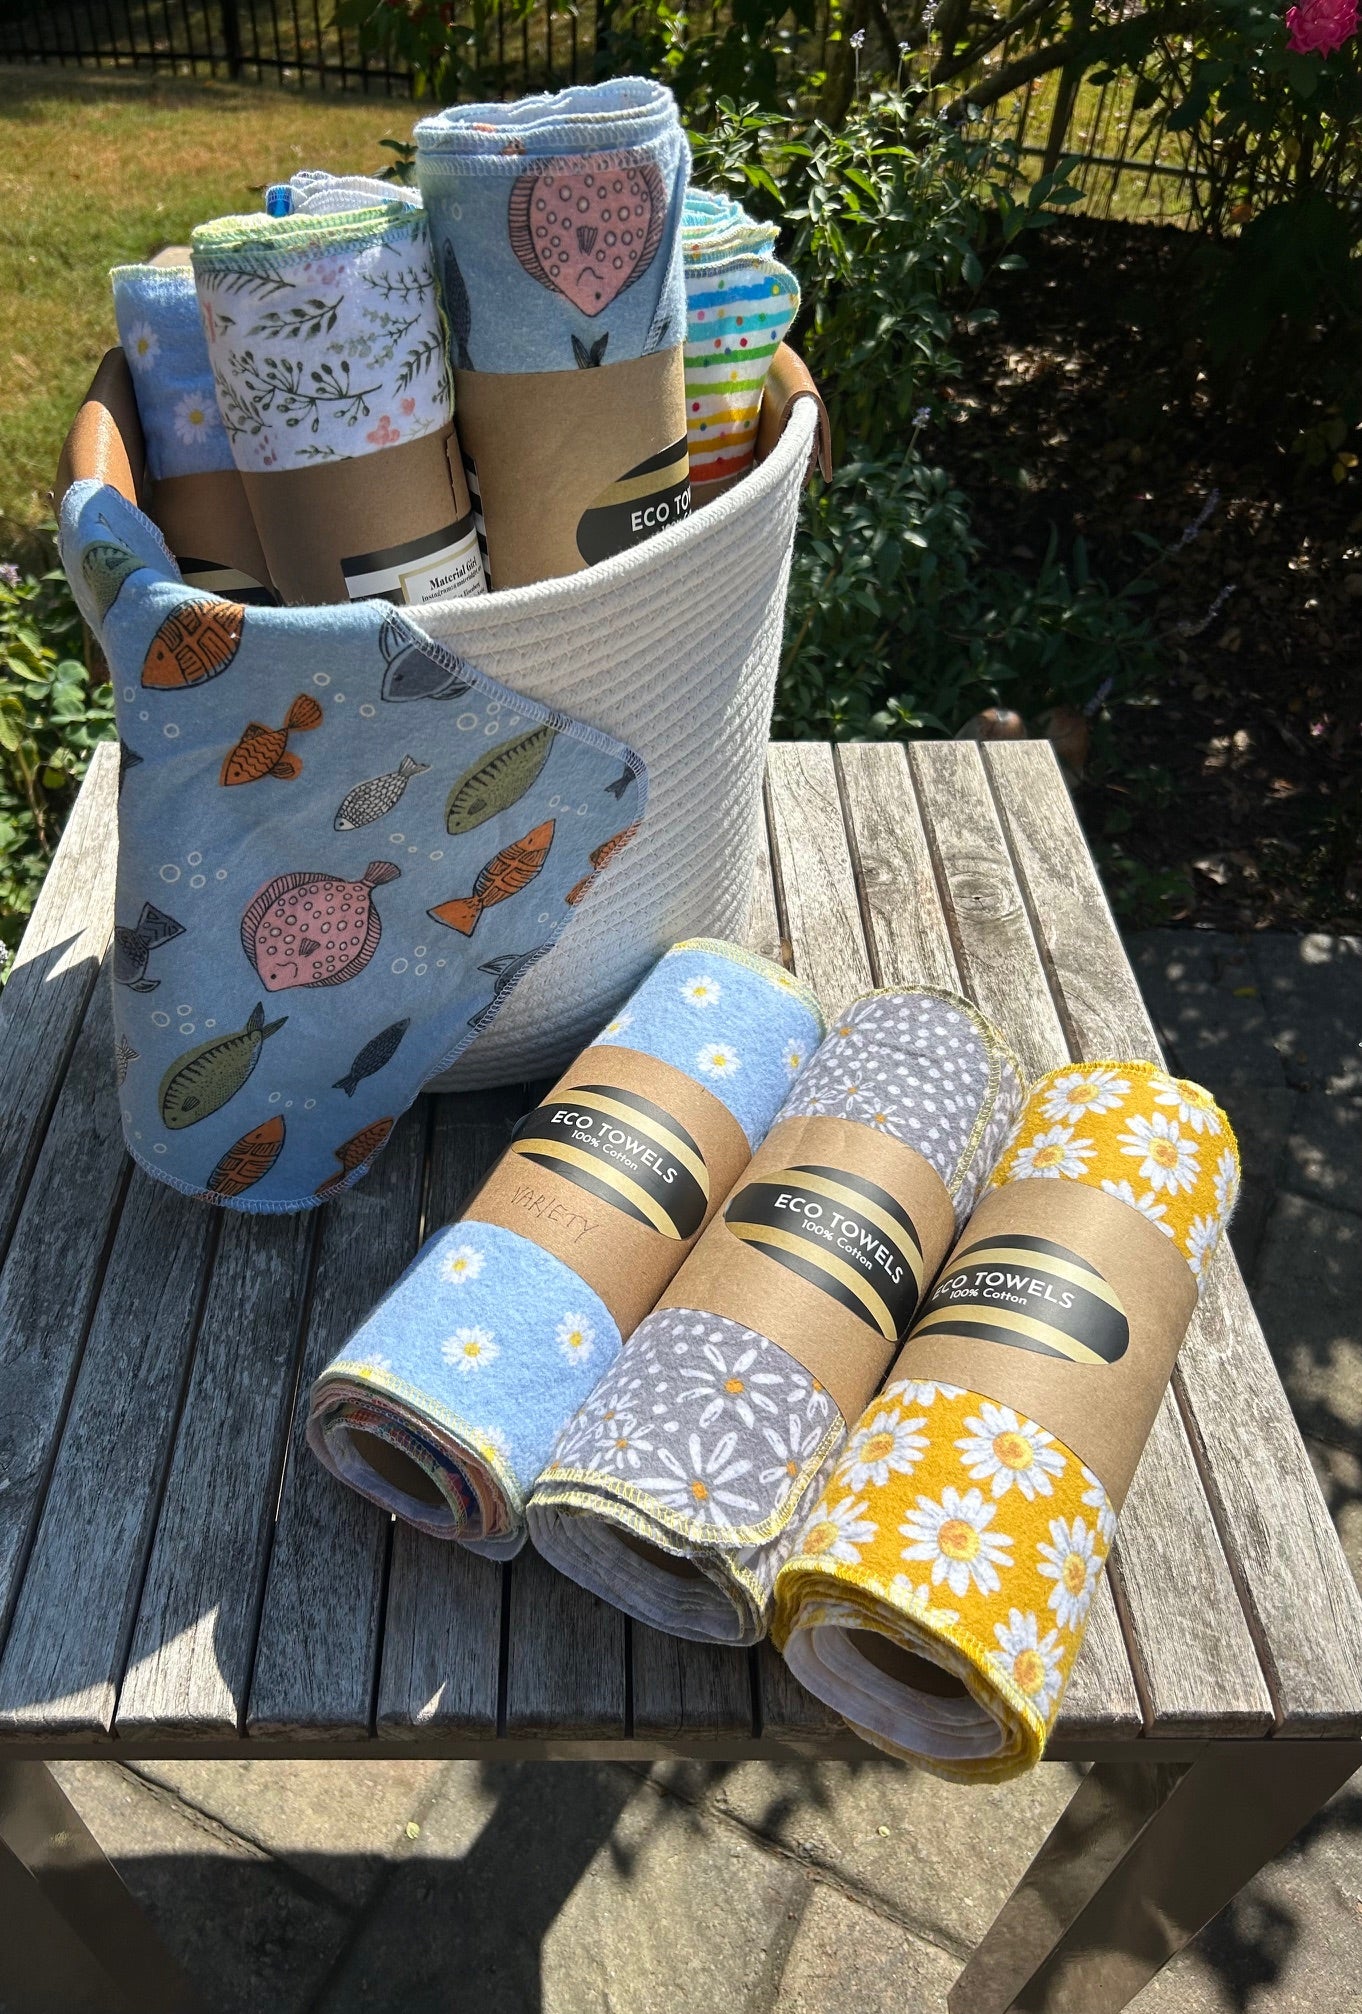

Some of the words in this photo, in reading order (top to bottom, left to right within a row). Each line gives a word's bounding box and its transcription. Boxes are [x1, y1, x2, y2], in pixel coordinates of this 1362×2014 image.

[631, 502, 670, 532] ECO
[429, 565, 466, 590] Material
[466, 556, 478, 571] Girl
[551, 1110, 593, 1129] ECO
[597, 1122, 678, 1184] TOWELS
[571, 1129, 601, 1148] 100%
[602, 1143, 638, 1171] Cotton
[511, 1186, 600, 1243] VARIETY
[774, 1193, 823, 1218] ECO
[830, 1211, 904, 1284] TOWELS
[801, 1219, 835, 1241] 100%
[836, 1237, 873, 1270] Cotton
[932, 1274, 968, 1301] ECO
[974, 1271, 1076, 1309] TOWELS
[949, 1288, 979, 1300] 100%
[982, 1287, 1028, 1306] Cotton
